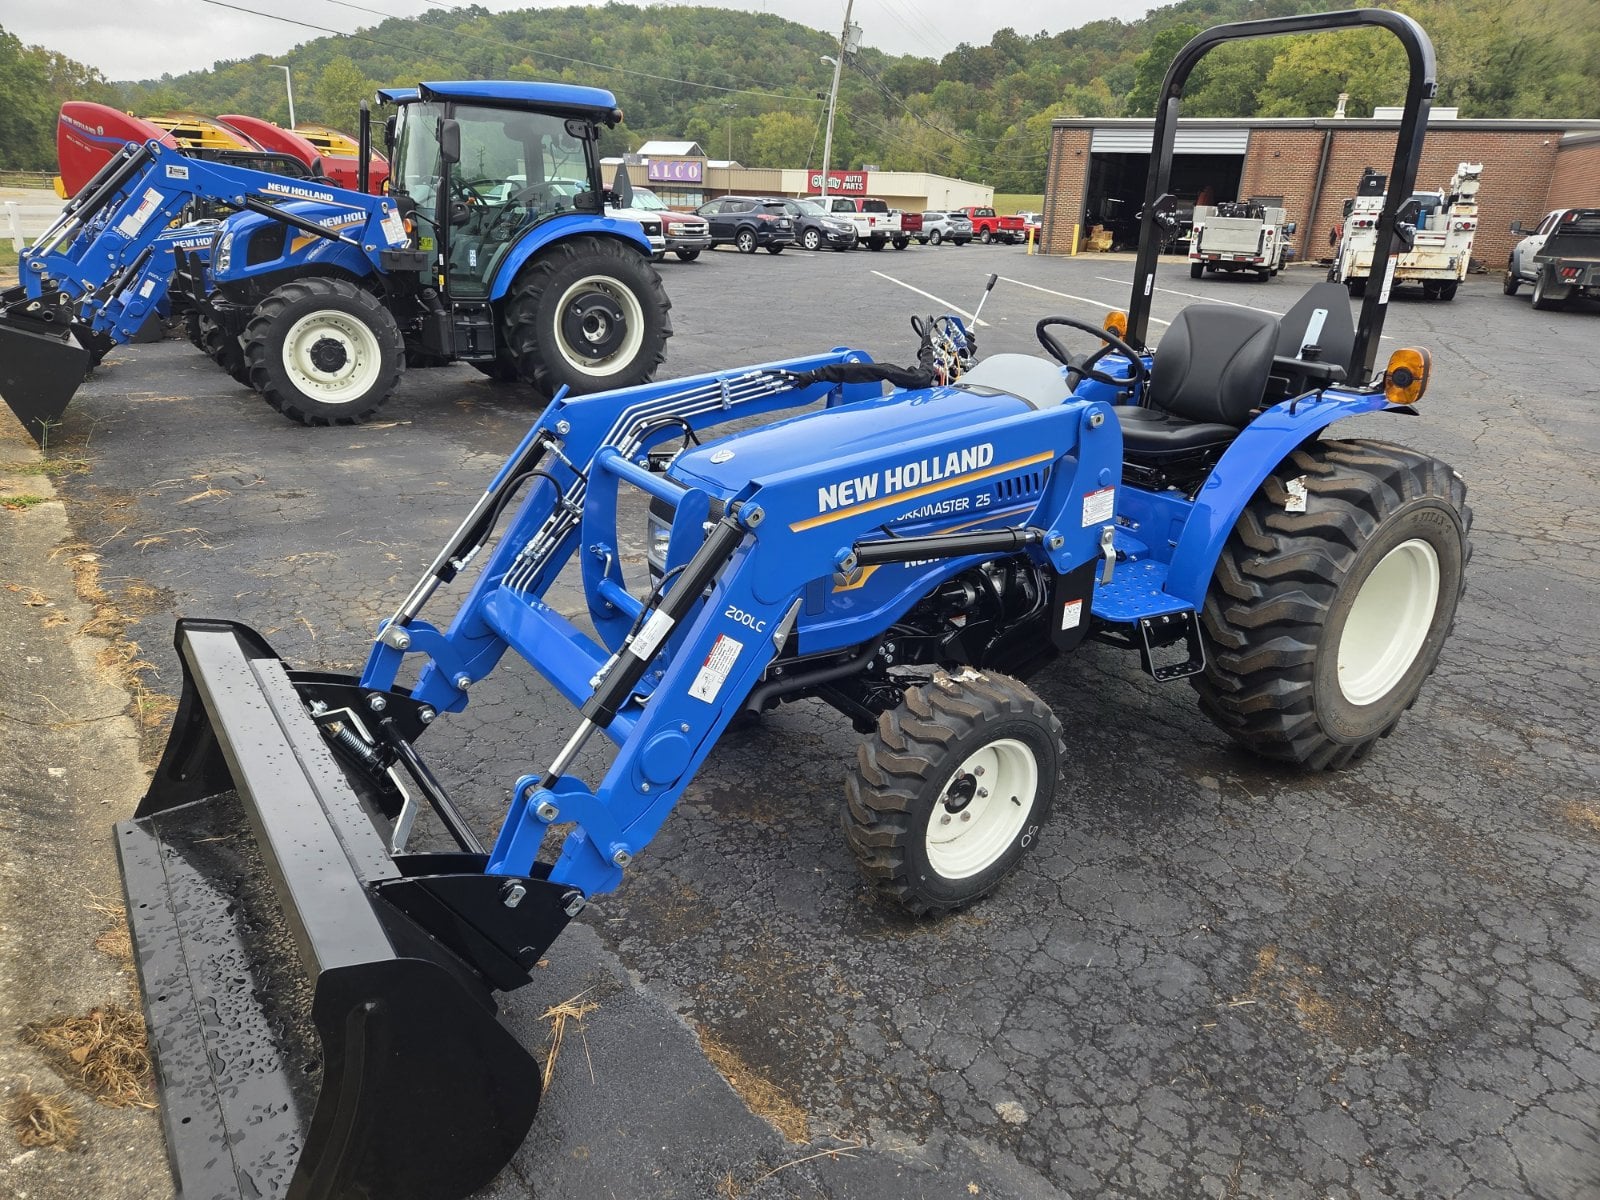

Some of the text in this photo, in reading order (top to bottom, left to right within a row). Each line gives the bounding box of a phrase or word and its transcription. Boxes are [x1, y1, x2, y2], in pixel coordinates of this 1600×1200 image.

[650, 164, 698, 179] ALCO
[845, 175, 863, 183] AUTO
[267, 182, 334, 202] NEW HOLLAND
[842, 182, 864, 190] PARTS
[319, 211, 367, 228] NEW HOLL
[818, 442, 995, 512] NEW HOLLAND
[975, 493, 991, 508] 25
[724, 604, 767, 633] 200LC
